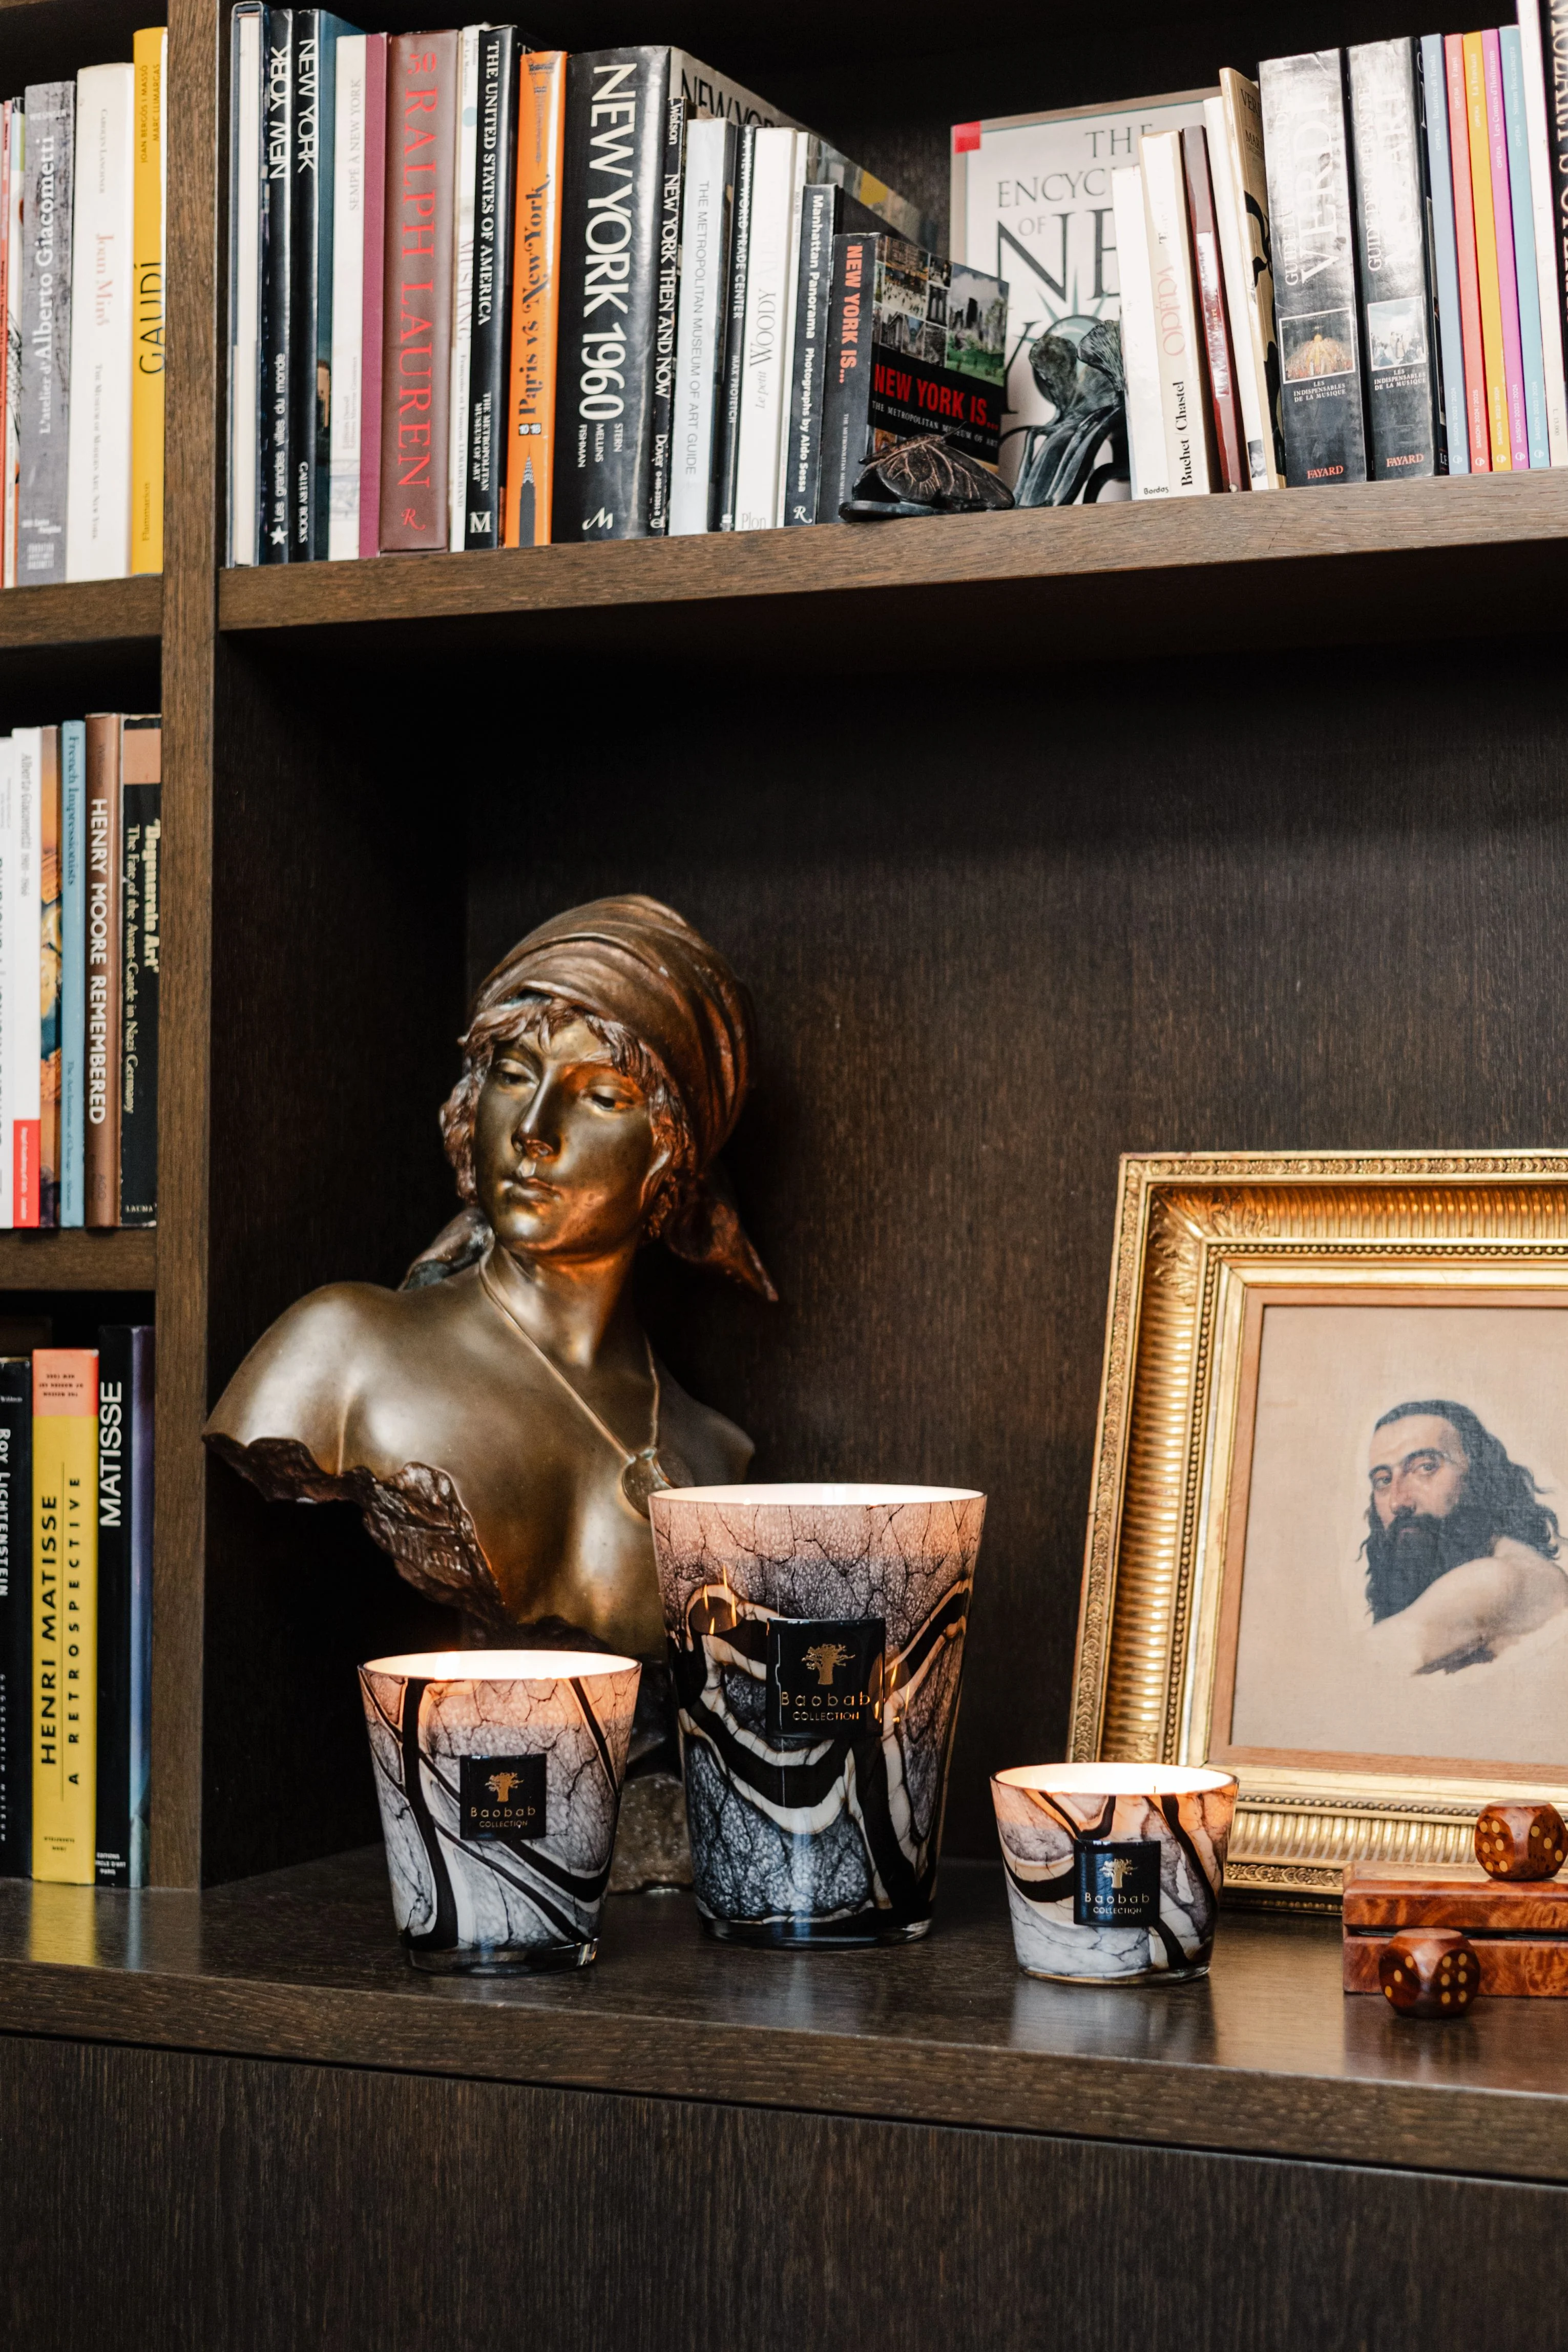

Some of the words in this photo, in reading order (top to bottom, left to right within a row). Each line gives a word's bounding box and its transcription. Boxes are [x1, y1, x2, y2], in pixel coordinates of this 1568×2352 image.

[269, 47, 291, 111] YORK
[298, 39, 319, 96] NEW
[407, 52, 437, 74] 50
[486, 40, 500, 80] THE
[1429, 54, 1437, 77] Tenda
[1489, 50, 1499, 95] d'Hoffmann
[1509, 47, 1519, 89] Boccanegra
[350, 78, 362, 115] YORK
[483, 81, 499, 150] UNITED
[1357, 86, 1371, 109] DE
[1491, 96, 1500, 122] Contes
[297, 106, 318, 173] YORK
[349, 118, 361, 151] NEW
[589, 63, 637, 178] NEW
[668, 102, 682, 145] Watson
[269, 121, 290, 179] NEW
[349, 155, 360, 163] À
[1359, 112, 1376, 179] OPERAS
[348, 169, 360, 212] SEMPÉ
[401, 88, 438, 259] RALPH
[481, 154, 496, 215] STATES
[663, 174, 680, 210] NEW
[698, 180, 709, 207] THE
[997, 166, 1117, 209] ENCYC
[1291, 96, 1340, 284] VERDI
[35, 135, 54, 267] Giacometti
[1363, 182, 1378, 214] DES
[480, 218, 494, 240] OF
[661, 214, 679, 263] YORK
[811, 194, 824, 268] Manhattan
[1018, 217, 1047, 237] OF
[1366, 219, 1382, 272] GUIDE
[95, 234, 115, 274] Joan
[582, 182, 634, 318] YORK
[692, 212, 708, 314] METROPOLITAN
[736, 232, 748, 270] TRADE
[844, 245, 864, 287] NEW
[1284, 233, 1300, 286] GUIDE
[477, 245, 493, 326] AMERICA
[522, 253, 549, 314] New
[659, 265, 677, 311] THEN
[733, 275, 746, 319] CENTER
[32, 276, 52, 373] d'Alberto
[134, 262, 165, 375] GAUDÍ
[806, 271, 820, 340] Panorama
[841, 293, 861, 345] YORK
[522, 321, 538, 346] vs
[656, 316, 674, 355] AND
[689, 319, 703, 377] MUSEUM
[749, 288, 777, 368] WOODY
[275, 353, 286, 393] monde
[398, 281, 433, 488] LAUREN
[518, 353, 543, 415] Paris
[579, 323, 629, 421] 1960
[655, 357, 672, 399] NOW
[731, 355, 741, 376] MAX
[756, 370, 767, 393] petit
[801, 347, 815, 416] Photographs
[1373, 372, 1427, 386] INDISPENSABLES
[1396, 377, 1427, 388] MUSIQUE
[39, 376, 52, 434] L'atelier
[276, 398, 285, 414] du
[483, 392, 492, 412] THE
[688, 380, 701, 400] OF
[755, 394, 767, 410] Le
[874, 363, 912, 403] NEW
[916, 378, 966, 420] YORK
[1172, 380, 1189, 431] Chastel
[1293, 383, 1346, 397] INDISPENSABLES
[1316, 388, 1347, 399] MUSIQUE
[274, 419, 285, 447] villes
[473, 403, 483, 444] MUSEUM
[519, 424, 530, 435] 10
[530, 424, 541, 435] 18
[686, 404, 700, 426] ART
[801, 418, 812, 432] by
[872, 400, 885, 412] THE
[887, 406, 939, 430] METROPOLITAN
[974, 433, 984, 444] OF
[472, 446, 481, 460] OF
[480, 414, 491, 491] METROPOLITAN
[577, 424, 588, 468] FISHMAN
[595, 423, 605, 463] MELLINS
[613, 423, 624, 453] STERN
[651, 434, 668, 468] Dover
[684, 433, 698, 475] GUIDE
[799, 433, 811, 461] Aldo
[840, 426, 848, 471] METROPOLITAN
[274, 455, 287, 497] grandes
[472, 463, 480, 482] ART
[798, 463, 809, 493] Sessa
[1180, 440, 1194, 487] Buchet
[1307, 465, 1344, 480] FAYARD
[1386, 453, 1425, 468] FAYARD
[1143, 485, 1171, 496] Bordas
[273, 501, 285, 523] Les
[298, 507, 308, 544] BOOKS
[741, 512, 767, 530] Plon
[68, 736, 79, 783] French
[67, 786, 79, 886] Impressionists
[90, 798, 108, 875] HENRY
[127, 824, 140, 850] The
[127, 853, 139, 880] Fate
[126, 898, 139, 920] the
[127, 882, 139, 897] of
[90, 883, 108, 966] MOORE
[125, 922, 139, 1002] Avant-Garde
[126, 1005, 135, 1017] in
[89, 975, 107, 1125] REMEMBERED
[126, 1021, 138, 1052] Nazi
[123, 1055, 138, 1114] Germany
[0, 1428, 11, 1464] ROY
[99, 1381, 122, 1527] MATISSE
[0, 1472, 11, 1597] LICHTENSTEIN
[41, 1495, 57, 1641] MATISSE
[68, 1478, 80, 1743] RETROSPECTIVE
[41, 1659, 57, 1765] HENRI
[781, 1691, 871, 1706] Baobab
[792, 1711, 860, 1721] COLLECTION
[68, 1773, 80, 1785] A
[470, 1806, 536, 1818] Baobab
[1084, 1892, 1150, 1904] Baobab
[1093, 1906, 1142, 1914] COLLECTION
